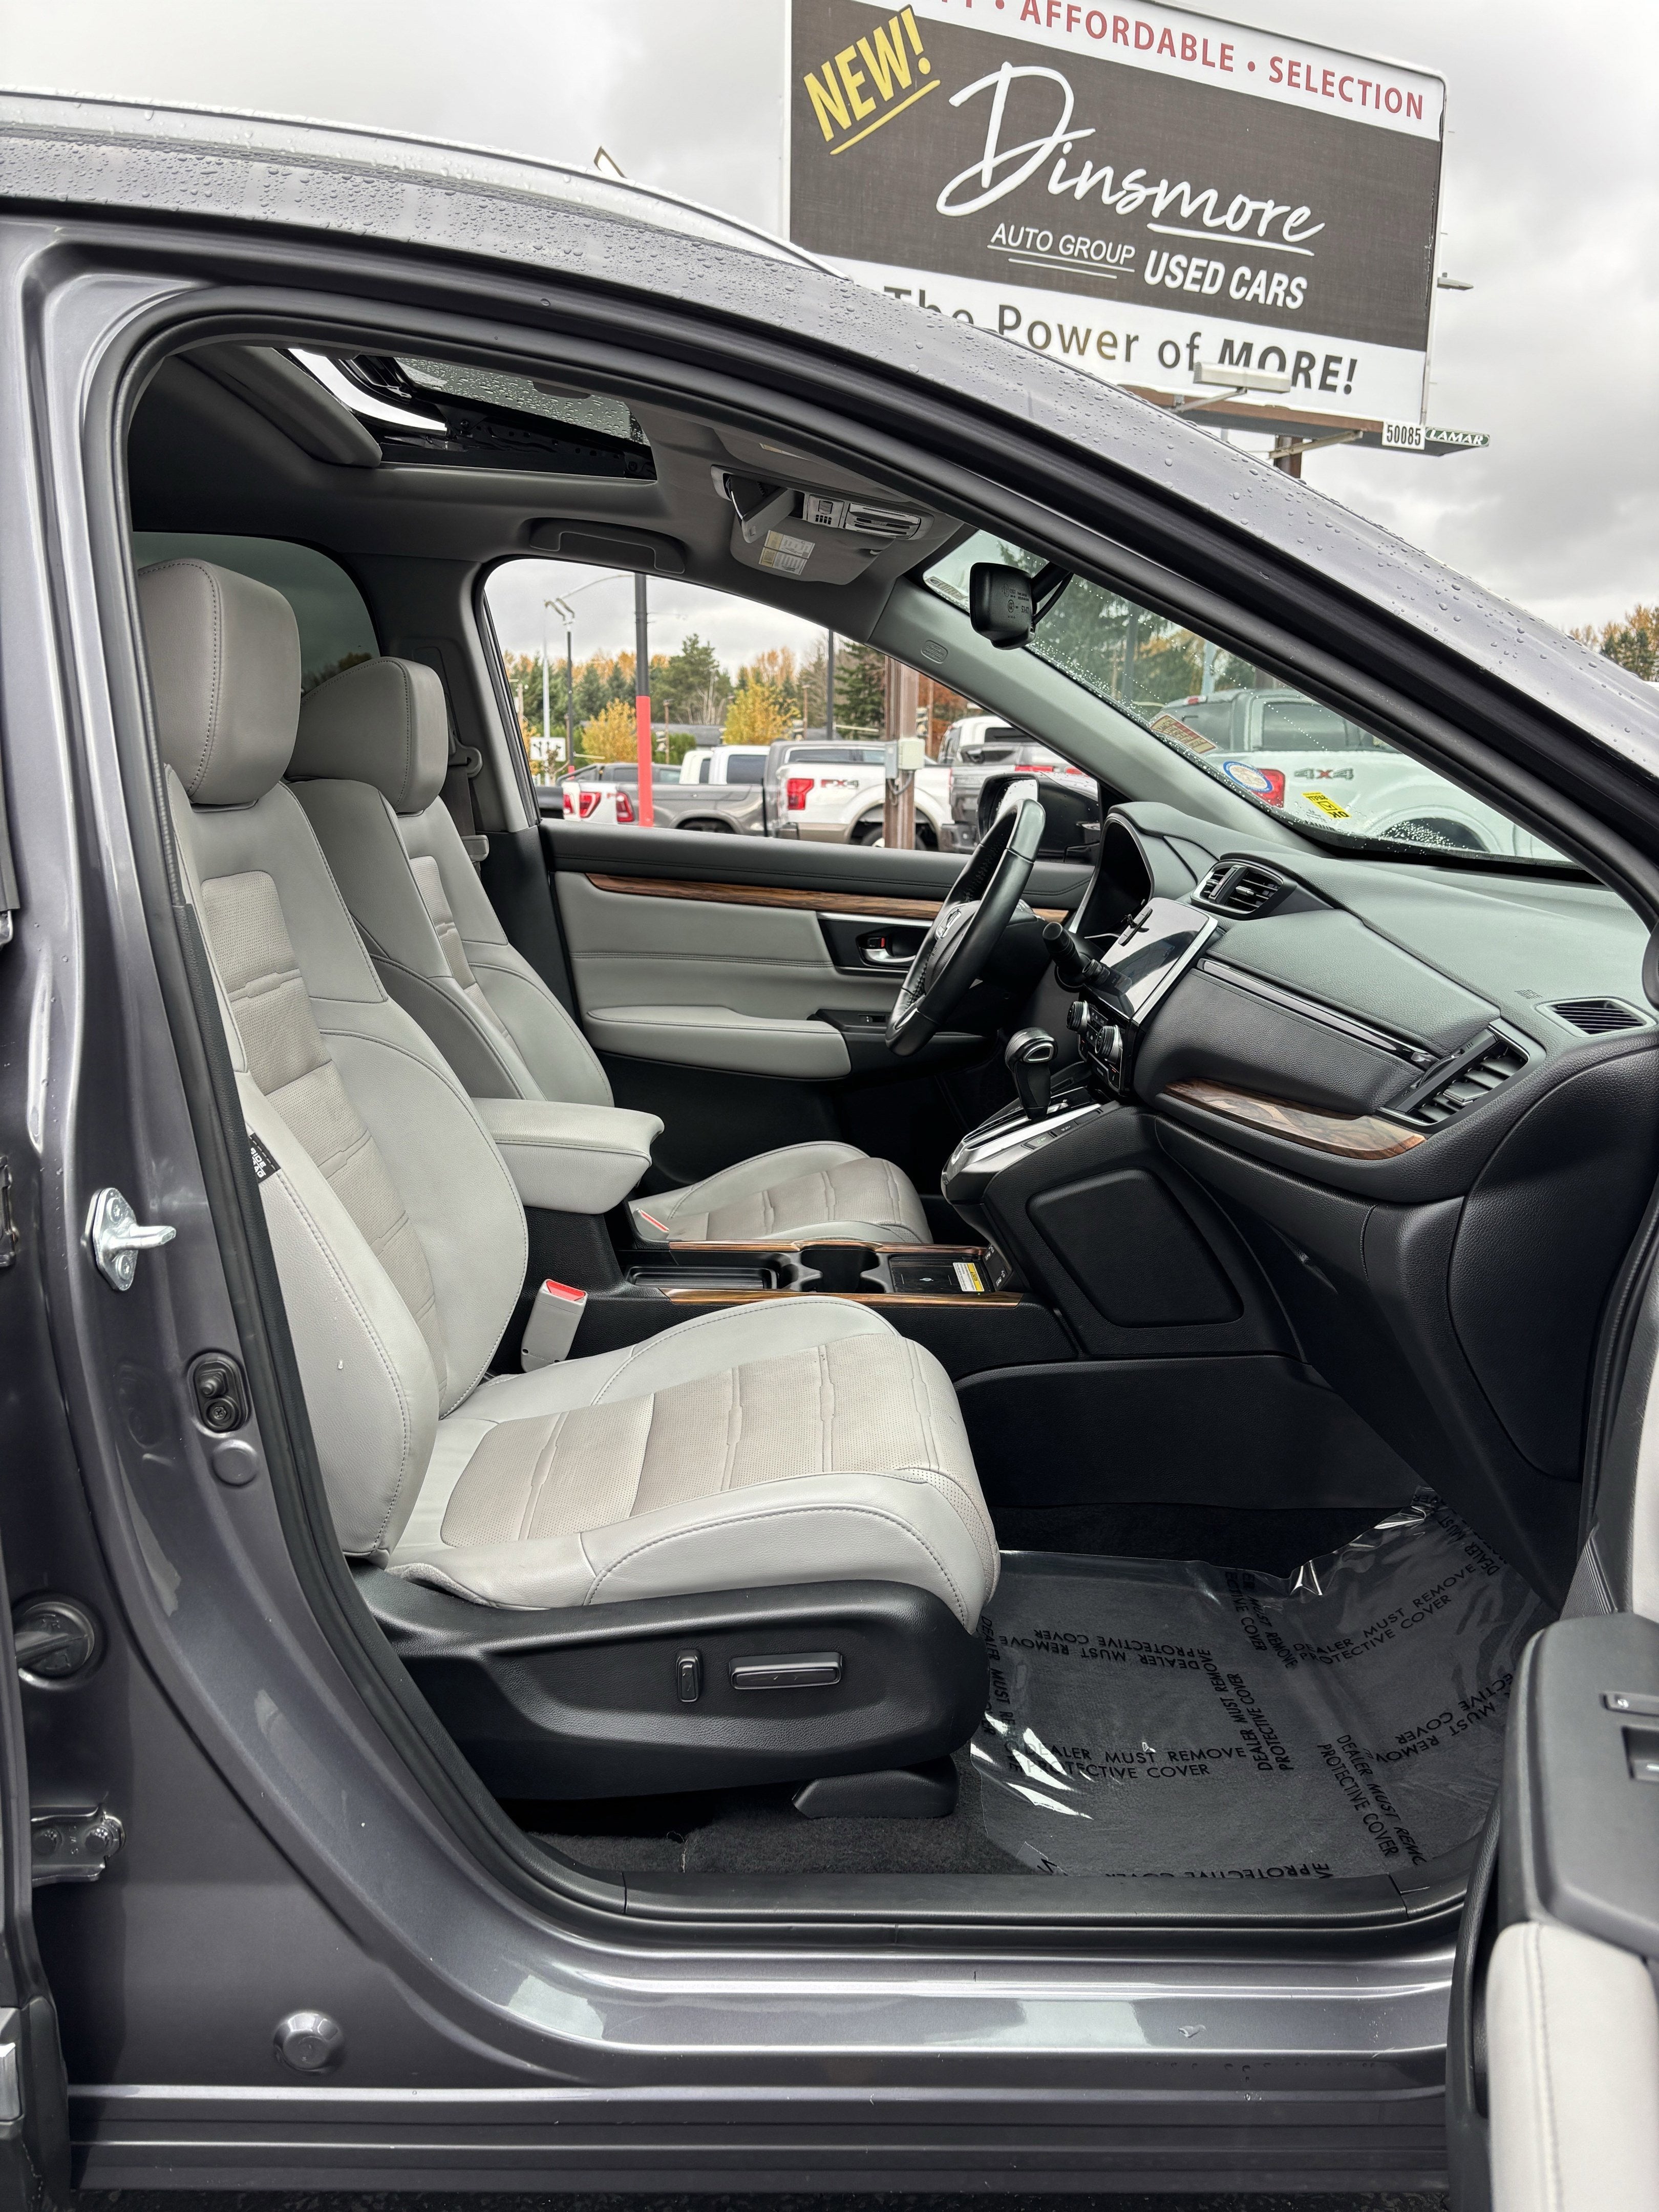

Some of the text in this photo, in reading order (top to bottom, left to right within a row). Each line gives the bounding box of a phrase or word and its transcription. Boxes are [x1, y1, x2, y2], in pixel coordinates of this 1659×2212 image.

[803, 7, 931, 142] NEW!
[1020, 0, 1423, 120] AFFORDABLE SELECTION
[935, 61, 1325, 243] Dinsmore
[990, 222, 1136, 266] AUTO GROUP
[1143, 249, 1308, 310] USED CARS
[998, 304, 1139, 363] Power
[1158, 331, 1202, 372] of
[1217, 338, 1358, 396] MORE!
[1386, 424, 1422, 446] 50085
[1428, 428, 1485, 446] LAMAR
[820, 778, 859, 789] FX4
[1464, 1541, 1501, 1576] DEALER
[1293, 1564, 1476, 1654] DEALER MUST REMOVE
[1300, 1594, 1452, 1664] PROTECTIVE COVER
[982, 1615, 1001, 1662] DEALER
[1000, 1636, 1201, 1670] DEALER MUST REMOVE
[1033, 1629, 1196, 1658] PROTECTIVE COVER
[1241, 1617, 1267, 1651] COVER
[1247, 1595, 1272, 1628] MUST
[1265, 1631, 1299, 1669] REMOVE
[990, 1668, 1011, 1705] MUST
[1197, 1648, 1273, 1771] DEALER MUST REMOVE
[1227, 1672, 1295, 1772] PROTECTIVE COVER
[1394, 1712, 1453, 1745] COVER
[1448, 1702, 1496, 1736] MUST
[1105, 1751, 1156, 1764] MUST
[1167, 1747, 1246, 1762] REMOVE
[1146, 1763, 1210, 1779] COVER
[1336, 1734, 1373, 1776] DEALER
[1366, 1783, 1401, 1822] MUST
[1317, 1743, 1370, 1811] PROTECTIVE
[1363, 1813, 1399, 1857] COVER
